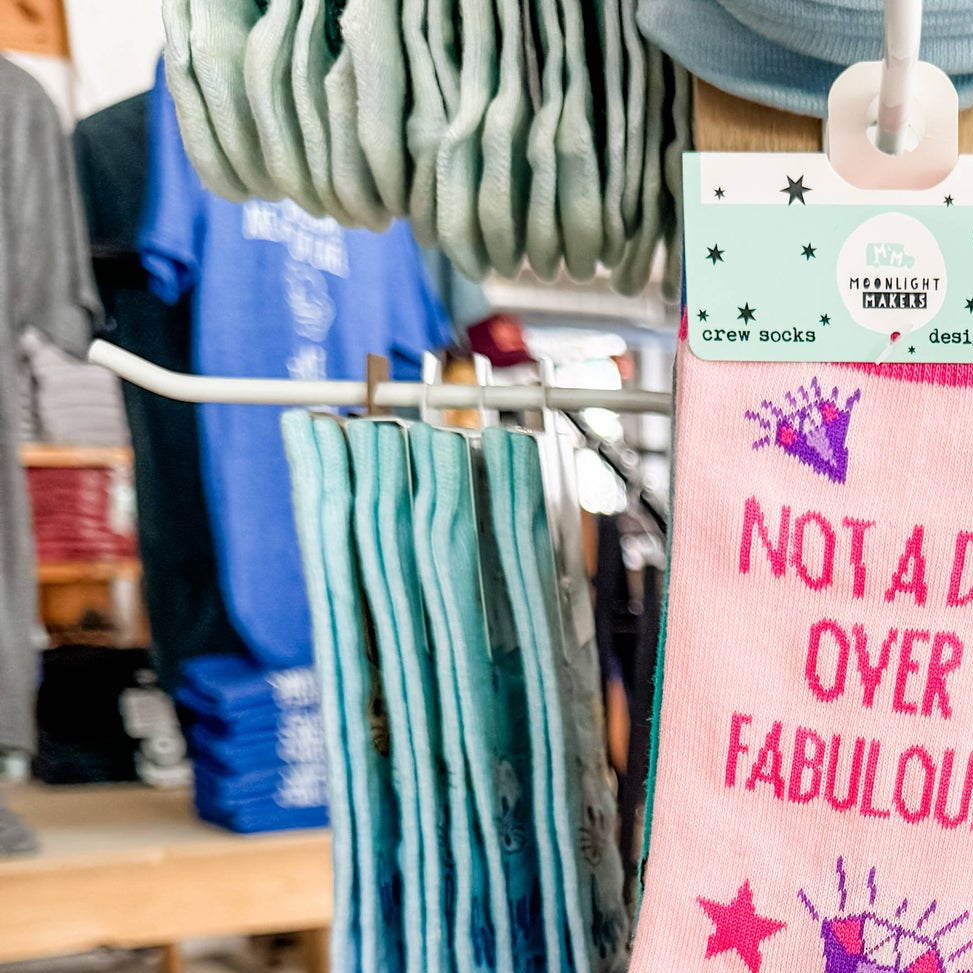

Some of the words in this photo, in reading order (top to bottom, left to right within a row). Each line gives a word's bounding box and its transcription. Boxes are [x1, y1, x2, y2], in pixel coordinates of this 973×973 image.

[849, 277, 940, 291] MOONLIGHT
[864, 293, 927, 308] MAKERS
[702, 329, 751, 342] crew
[759, 327, 816, 342] socks
[739, 495, 876, 600] NOT
[885, 524, 928, 608] A
[805, 617, 964, 720] OVER
